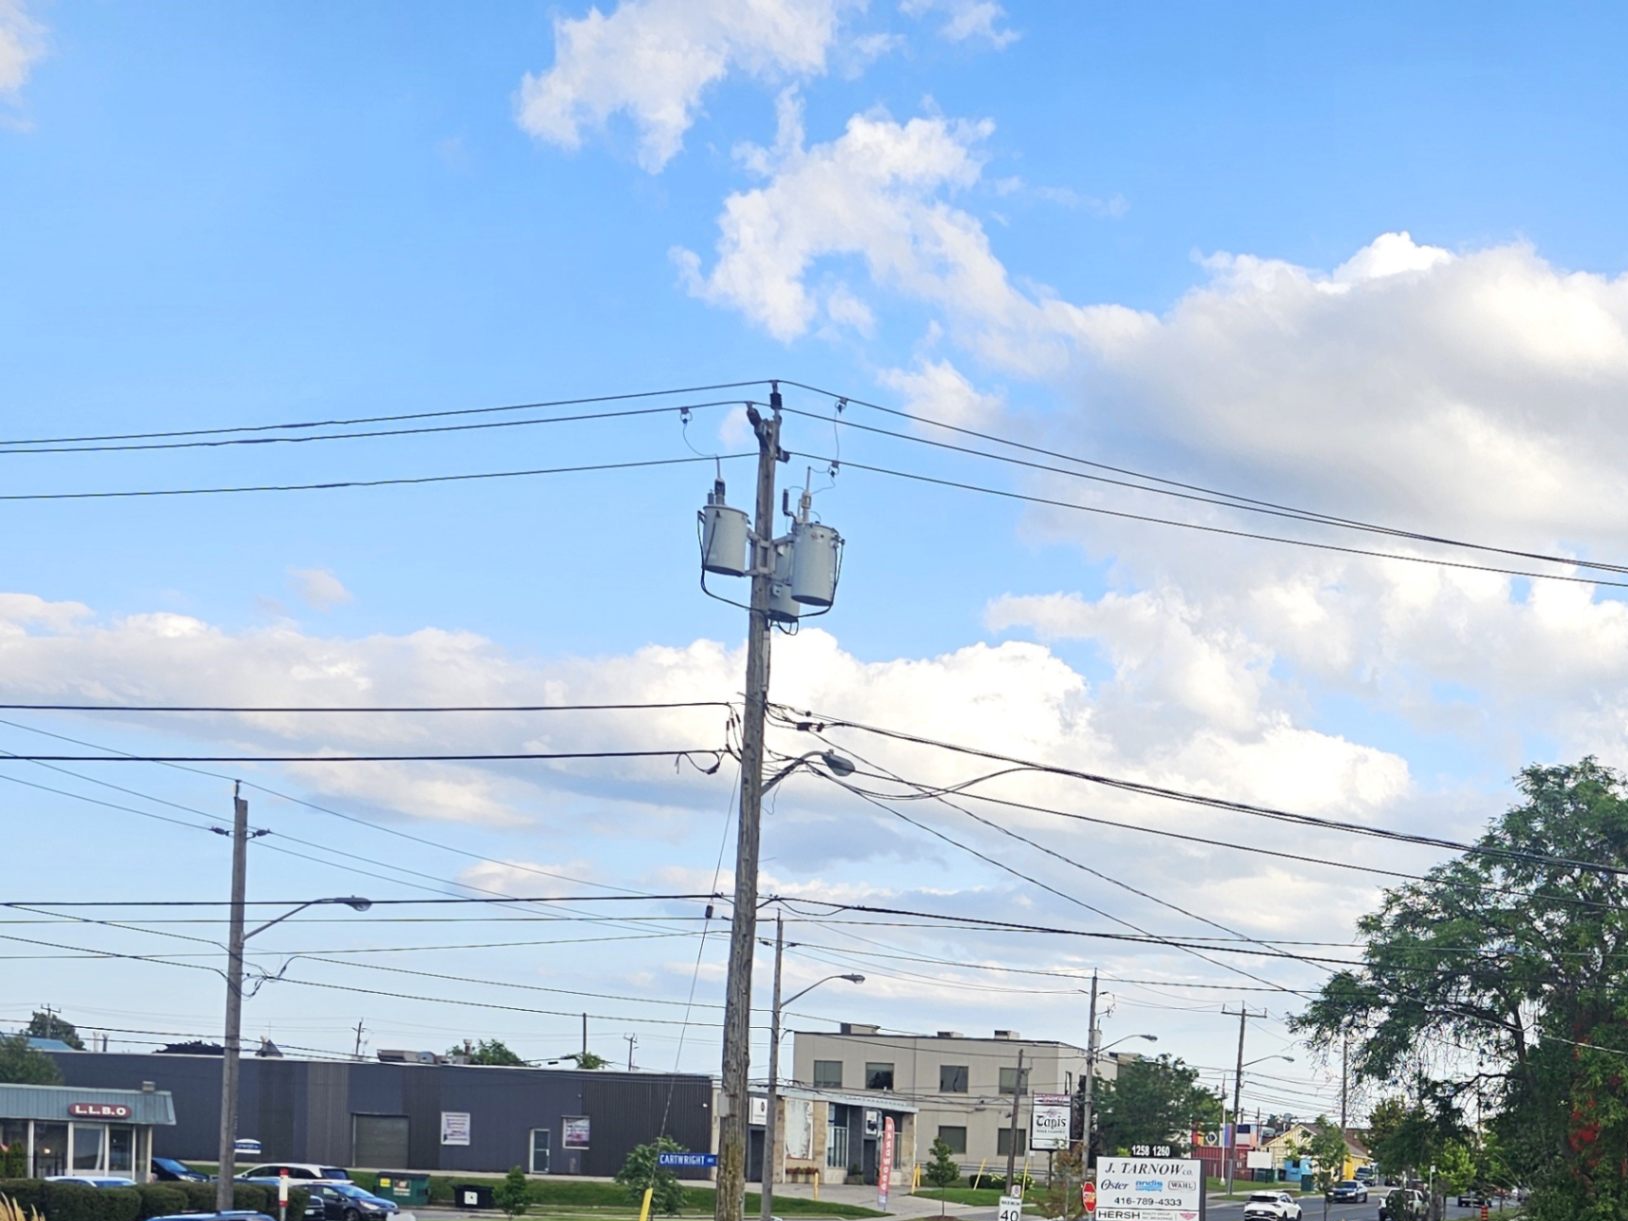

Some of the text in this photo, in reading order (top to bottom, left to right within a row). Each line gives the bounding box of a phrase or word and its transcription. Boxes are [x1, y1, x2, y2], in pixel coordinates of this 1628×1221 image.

[1036, 1115, 1067, 1129] Tapis
[1132, 1145, 1149, 1156] 1258
[660, 1154, 705, 1165] CARTWRIGHT
[1121, 1163, 1184, 1175] TARNOW
[1101, 1179, 1129, 1190] Oster
[1171, 1182, 1193, 1190] WAHL
[1098, 1211, 1140, 1219] HERSH
